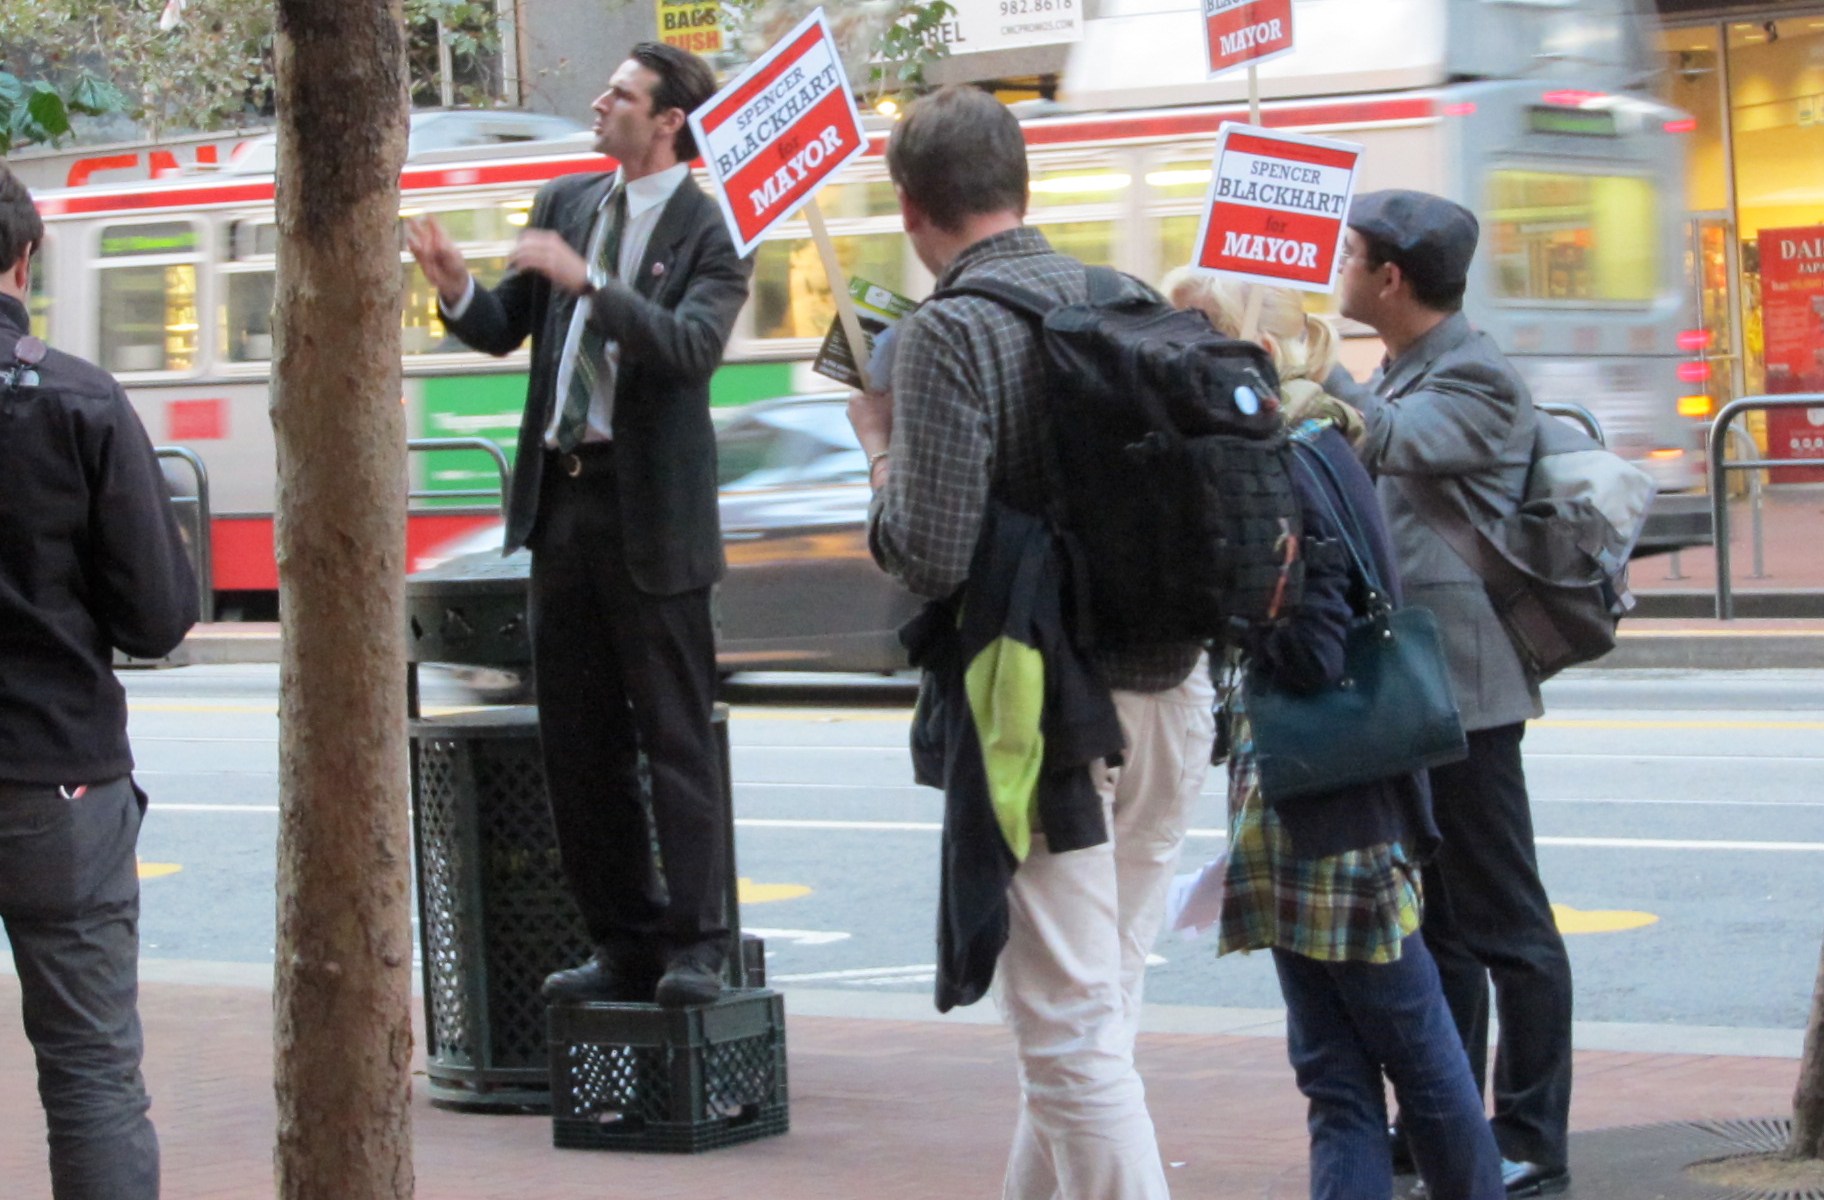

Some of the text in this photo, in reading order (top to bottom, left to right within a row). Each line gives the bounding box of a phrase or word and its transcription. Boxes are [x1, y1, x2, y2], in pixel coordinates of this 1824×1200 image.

[664, 7, 716, 30] BAGS
[1219, 17, 1283, 57] MAYOR
[736, 67, 805, 131] SPENCER
[717, 64, 836, 176] BLACKHART
[778, 136, 800, 160] for
[749, 125, 844, 217] MAYOR
[1250, 160, 1321, 185] SPENCER
[1217, 177, 1345, 214] BLACKHART
[1265, 215, 1288, 233] for
[1221, 231, 1319, 269] MAYOR
[1780, 238, 1824, 259] DAI
